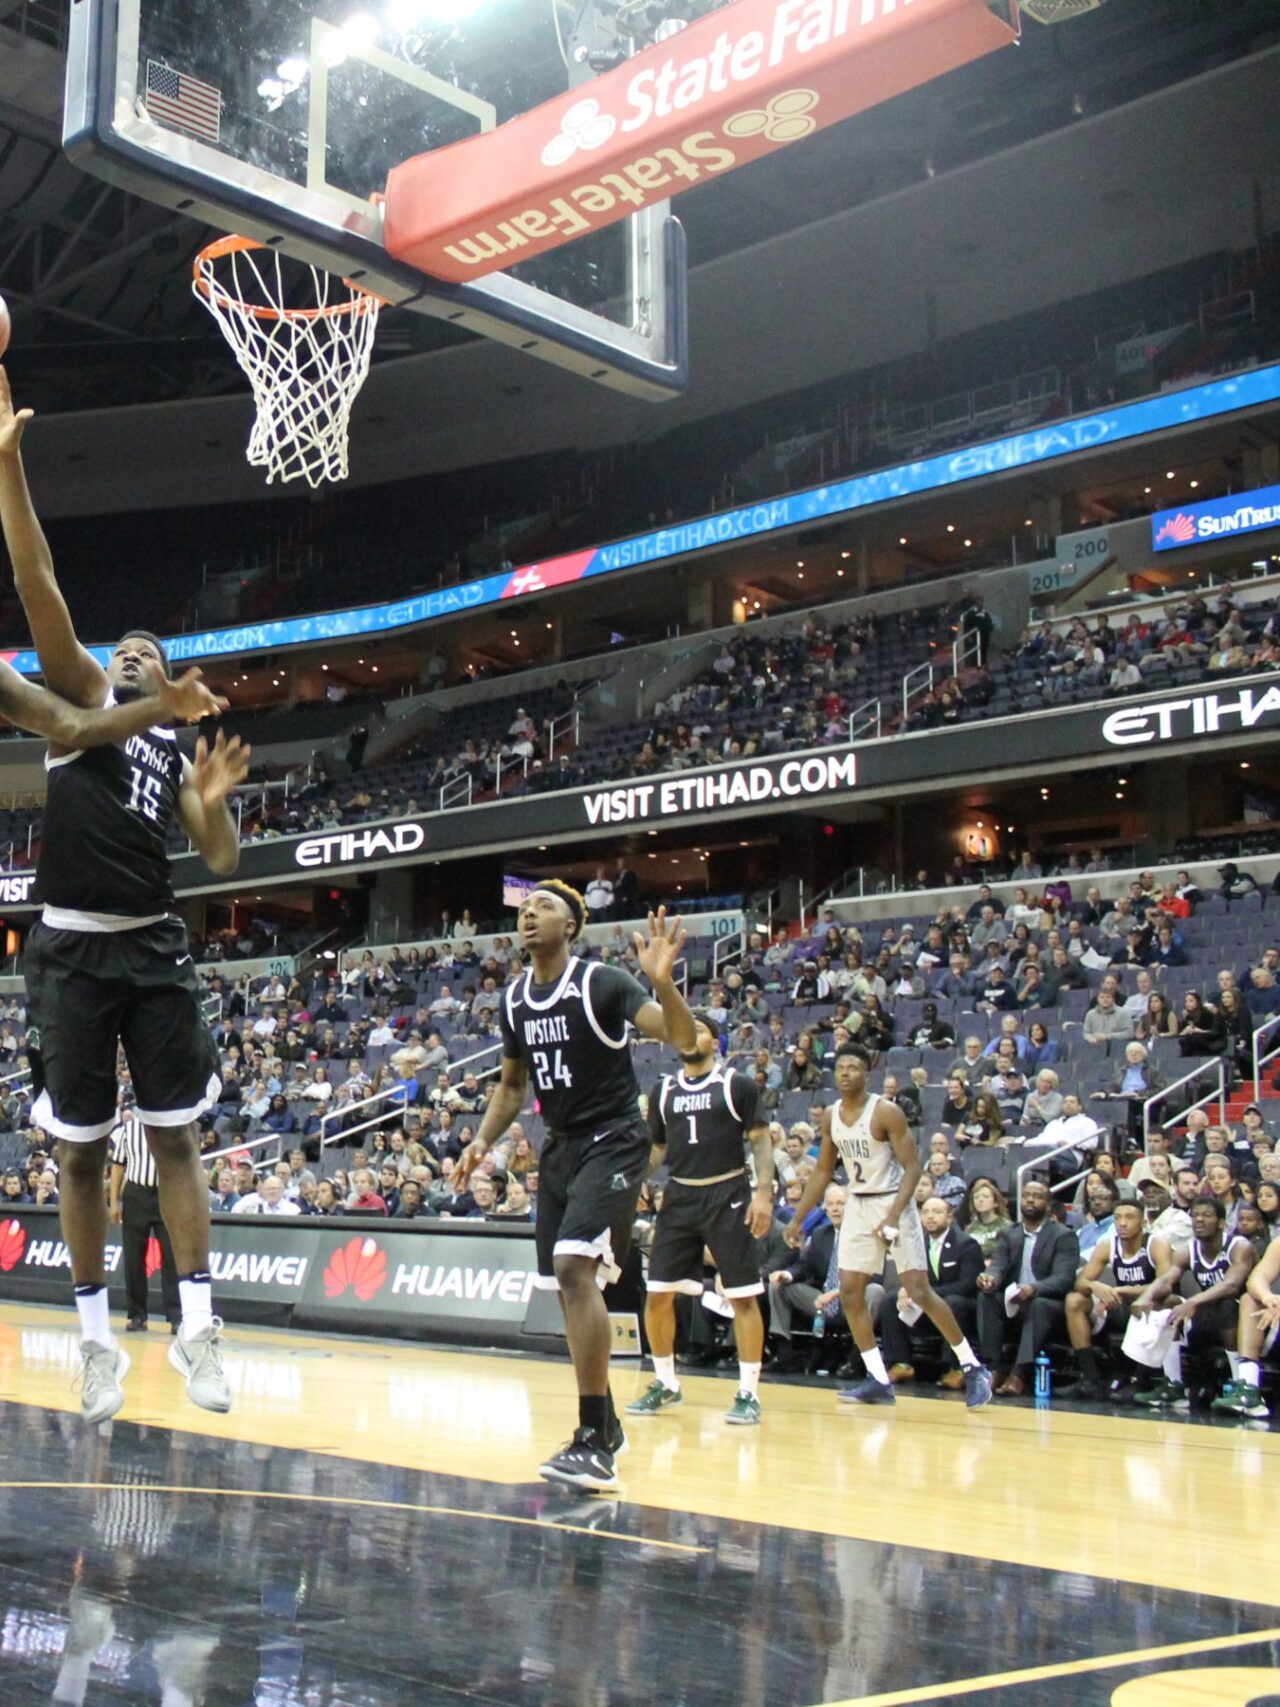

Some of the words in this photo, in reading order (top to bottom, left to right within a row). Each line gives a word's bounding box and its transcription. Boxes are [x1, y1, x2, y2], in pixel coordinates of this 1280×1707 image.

[950, 418, 1109, 477] ETIHAD
[601, 539, 649, 568] VISIT
[655, 501, 789, 555] ETIHAD.COM
[1074, 538, 1108, 559] 200
[1032, 572, 1060, 592] 201
[386, 585, 484, 624] ETIHAD
[166, 628, 265, 657] TIHAD.COM
[124, 766, 162, 820] 15
[583, 786, 654, 824] VISIT
[660, 753, 857, 814] ETIHAD.COM
[295, 823, 425, 866] ETIHAD
[711, 918, 736, 935] 101
[524, 1014, 570, 1046] UPSTATE
[532, 1049, 573, 1090] 24
[673, 1092, 712, 1113] UPSTATE
[686, 1115, 699, 1144] 1
[853, 1160, 867, 1184] 2
[25, 1239, 123, 1272] HUAEI
[392, 1263, 539, 1303] HUAWEI
